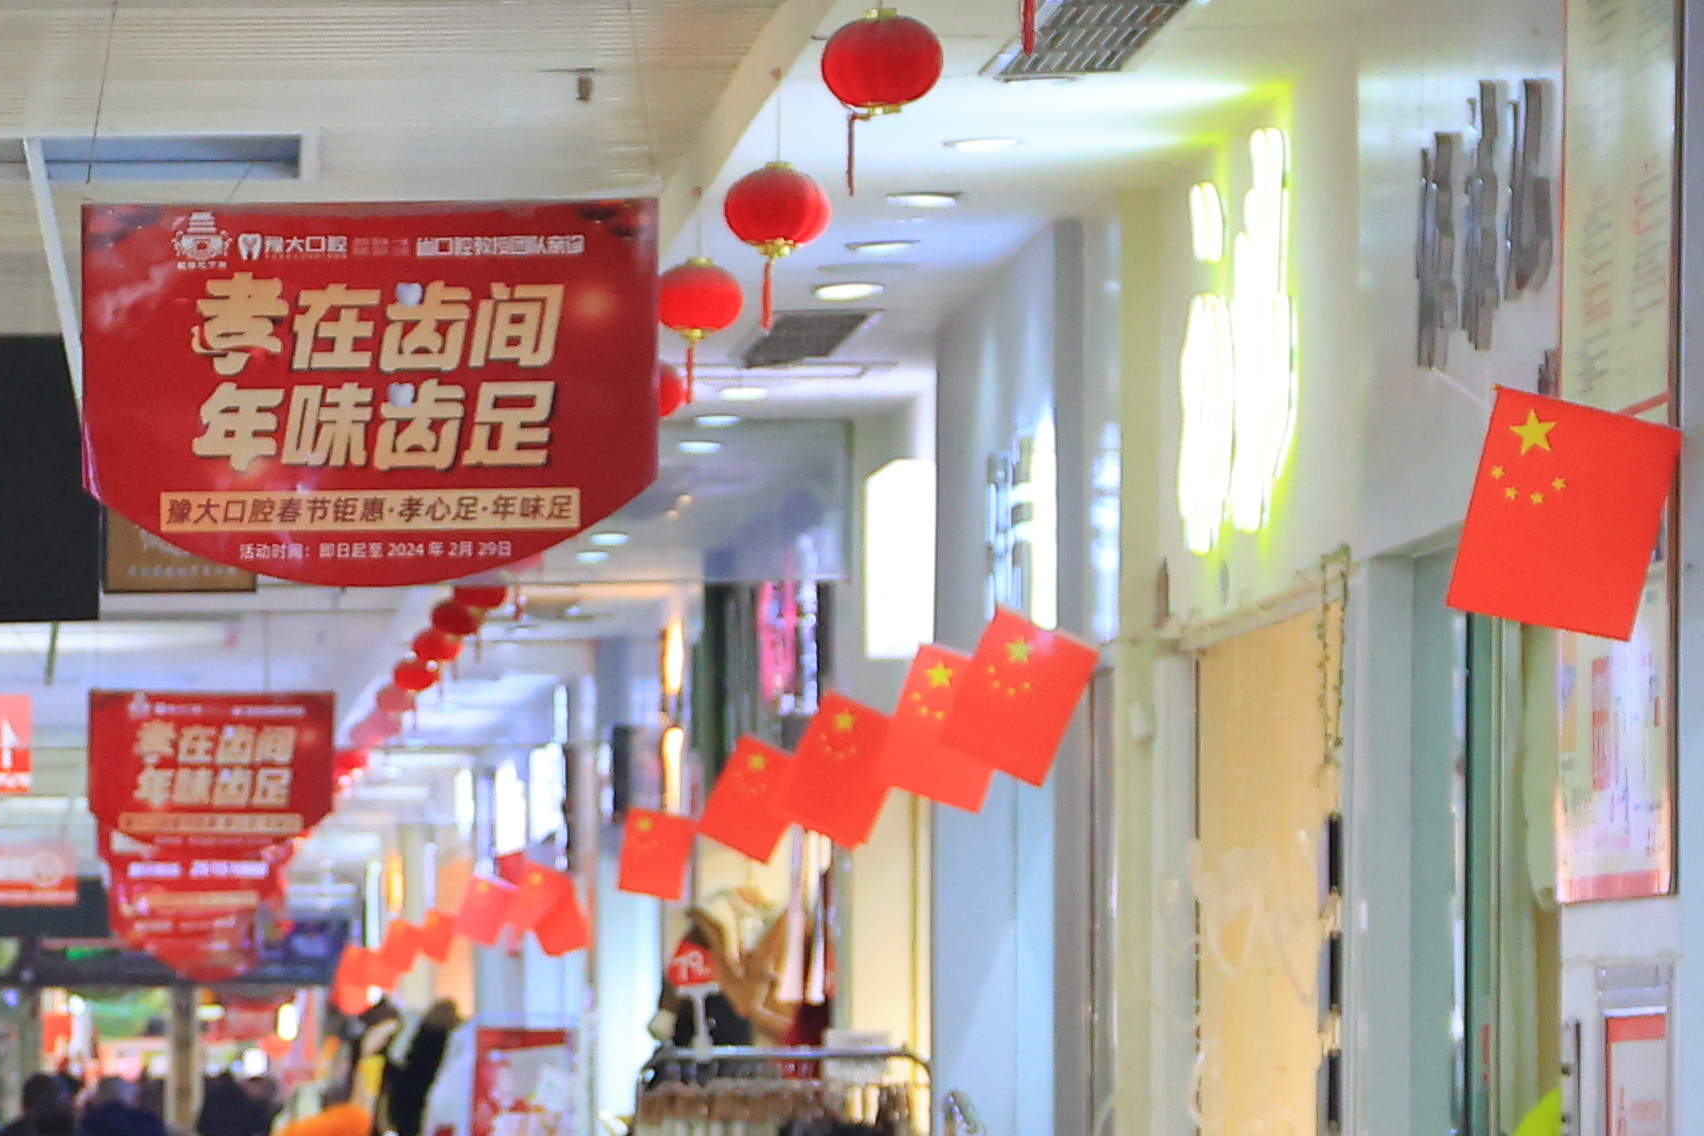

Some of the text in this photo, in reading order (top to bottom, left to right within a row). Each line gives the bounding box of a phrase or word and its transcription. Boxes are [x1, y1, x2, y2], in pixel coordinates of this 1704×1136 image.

[193, 272, 565, 375] 孝在齿间
[192, 379, 557, 472] 年味齿足
